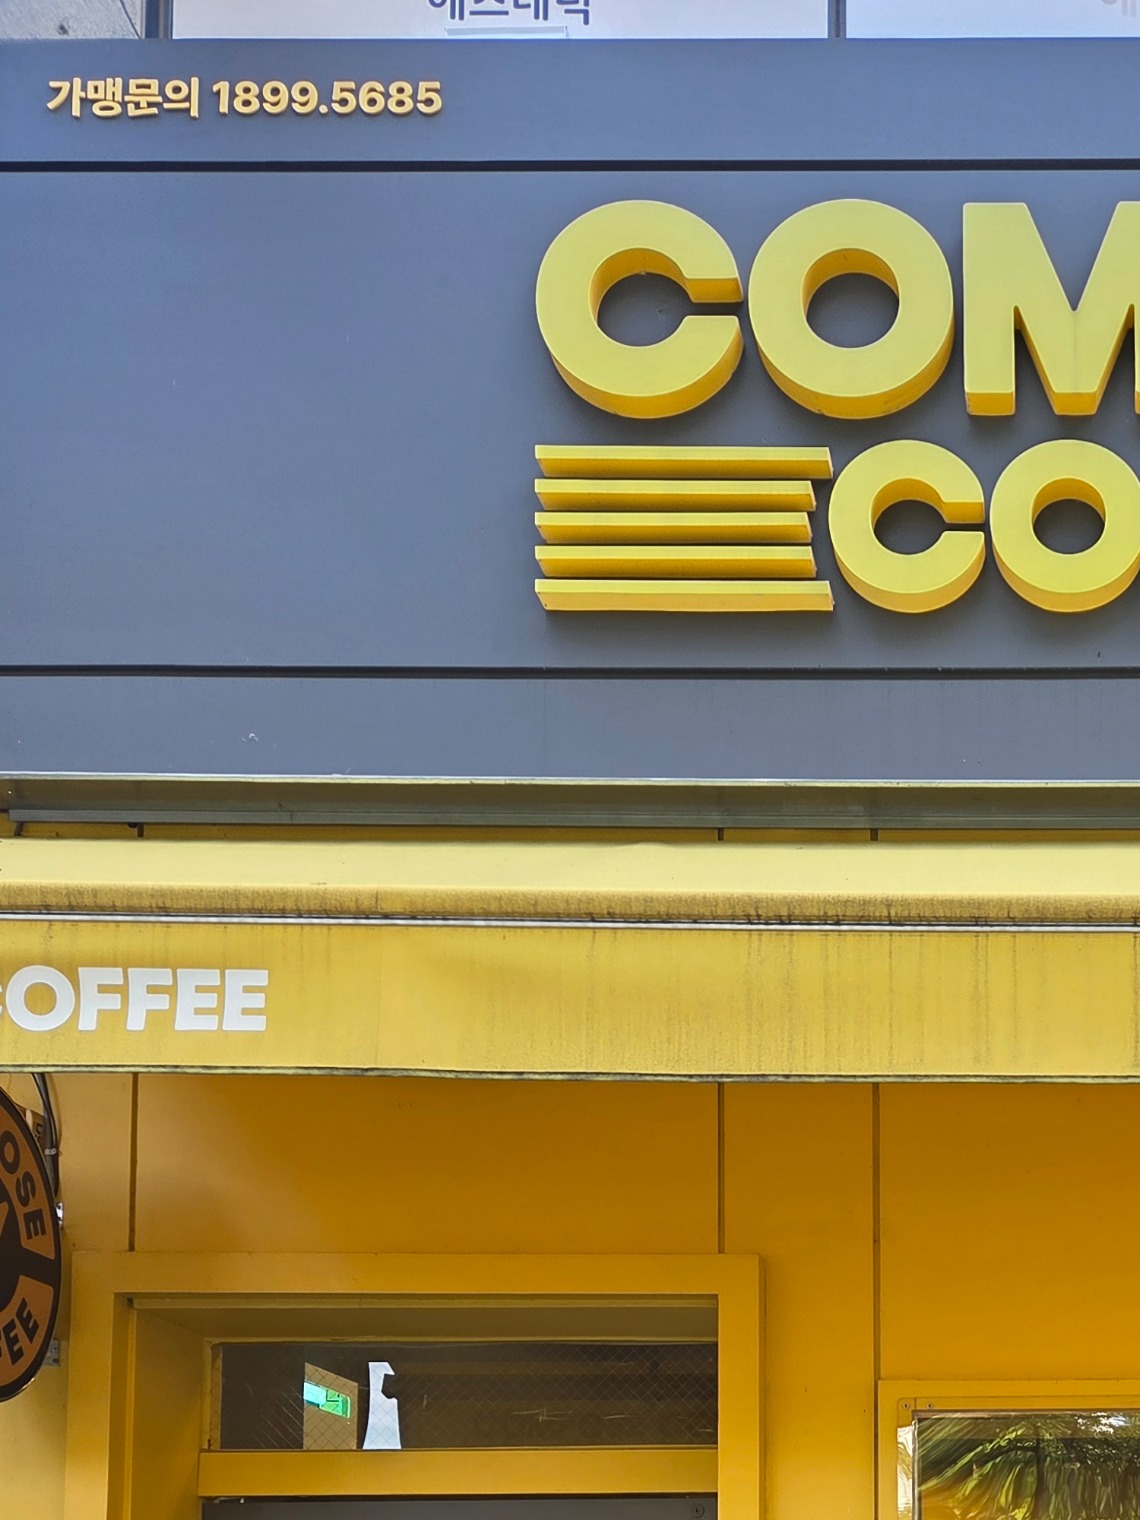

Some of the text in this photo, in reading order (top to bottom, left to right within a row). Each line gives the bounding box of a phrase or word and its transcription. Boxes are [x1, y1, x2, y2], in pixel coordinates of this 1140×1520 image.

[47, 77, 443, 118] 가맹문의 1899.5685
[0, 965, 269, 1032] OFFEE
